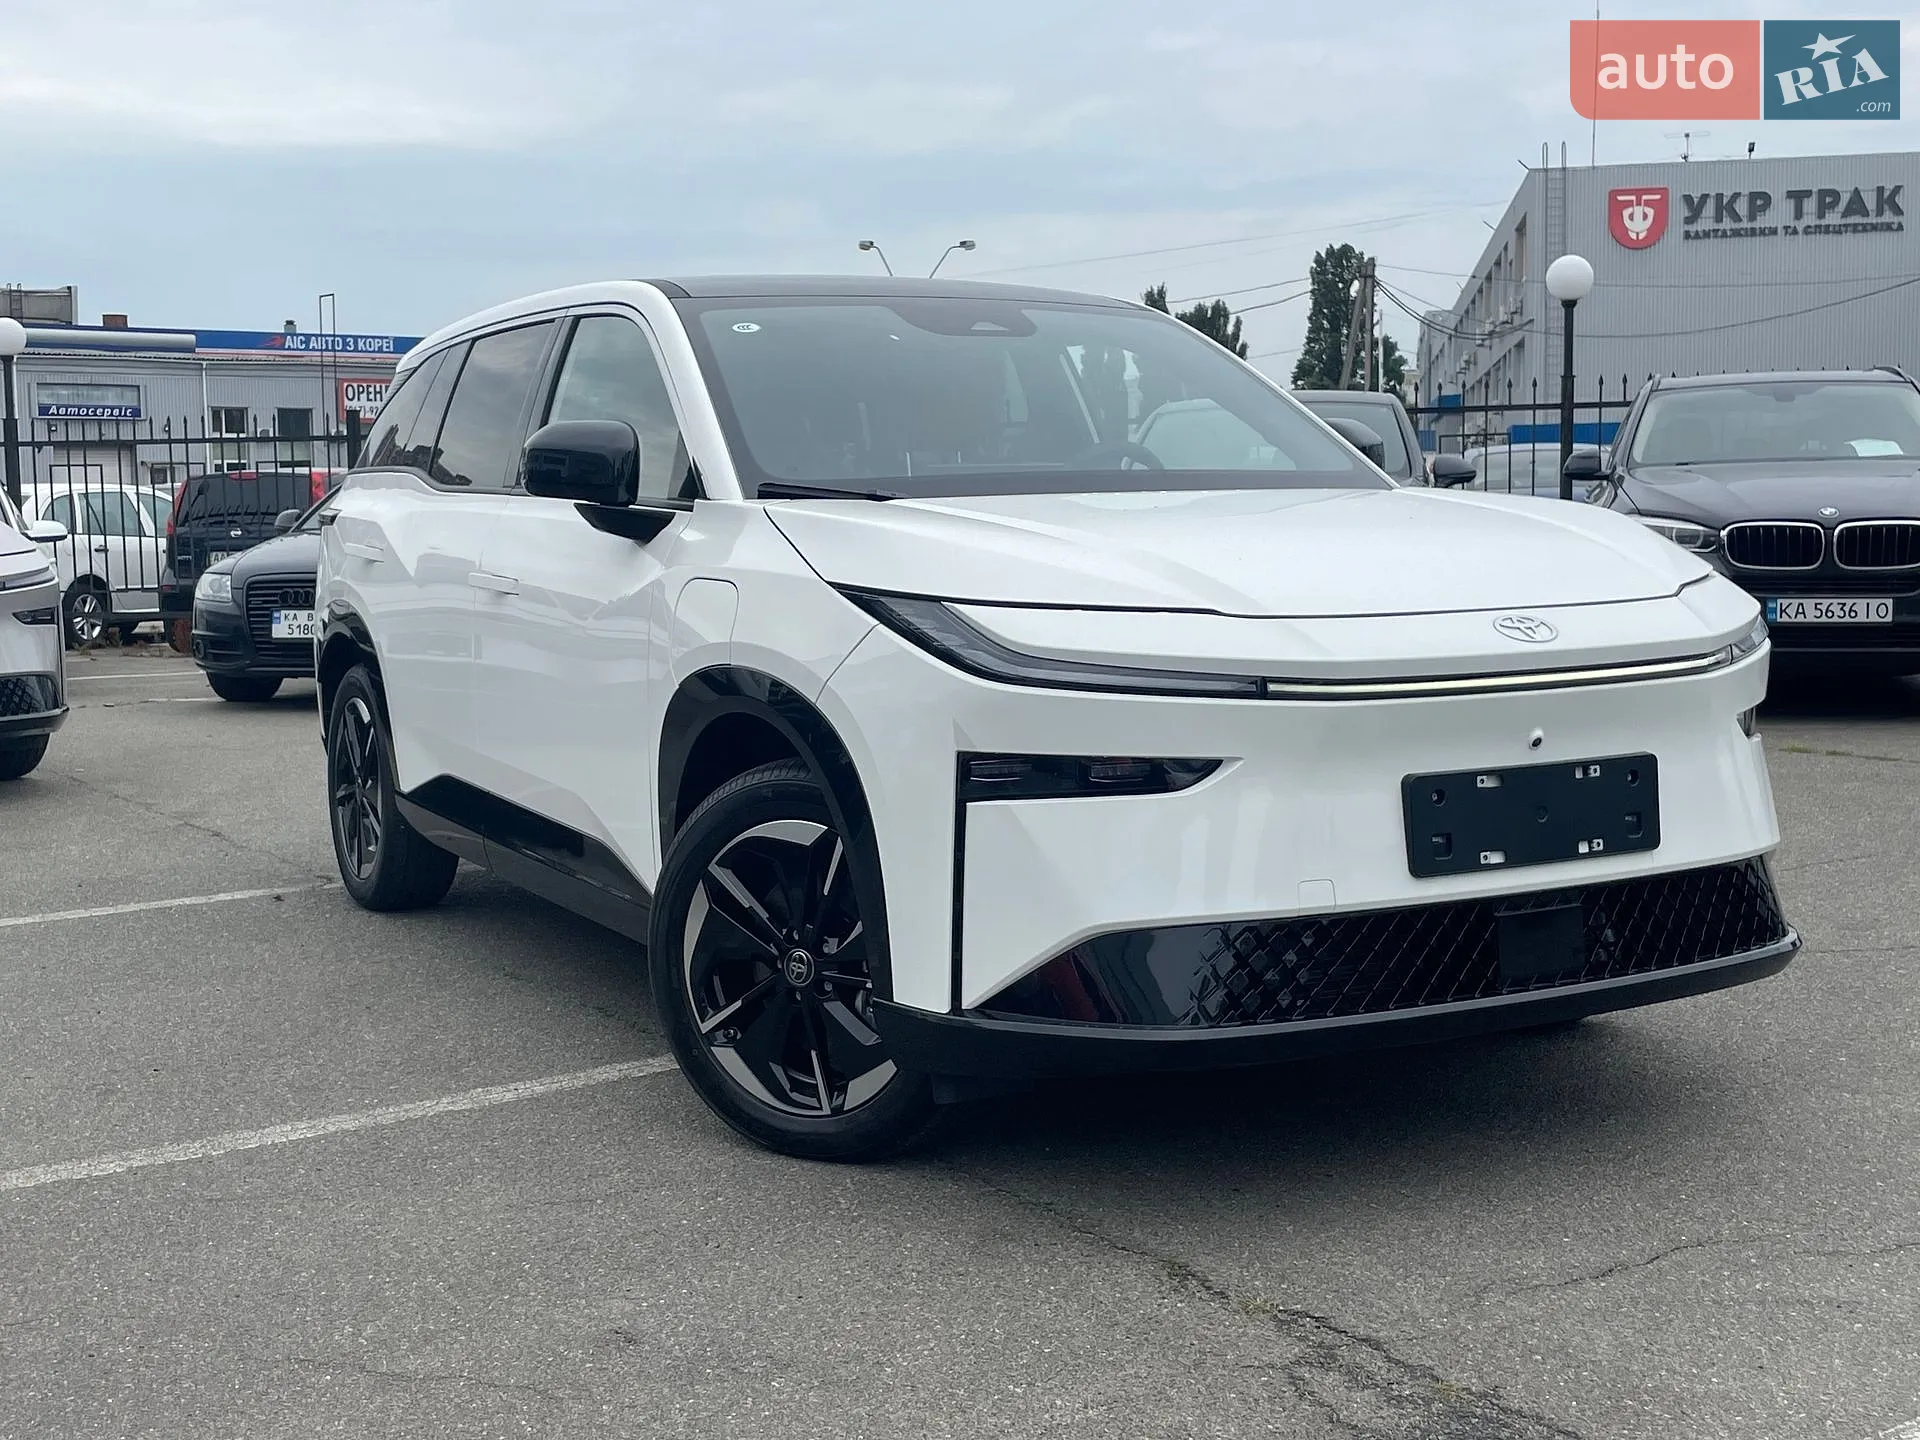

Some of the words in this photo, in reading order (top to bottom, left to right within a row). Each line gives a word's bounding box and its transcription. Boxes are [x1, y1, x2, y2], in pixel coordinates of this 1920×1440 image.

[1682, 191, 1773, 225] УКР
[1786, 185, 1904, 221] ТРАК
[1783, 225, 1799, 237] ТА
[48, 405, 133, 418] Автосервіс
[1779, 602, 1807, 619] KA
[1814, 602, 1858, 619] 5636
[284, 613, 298, 622] KA
